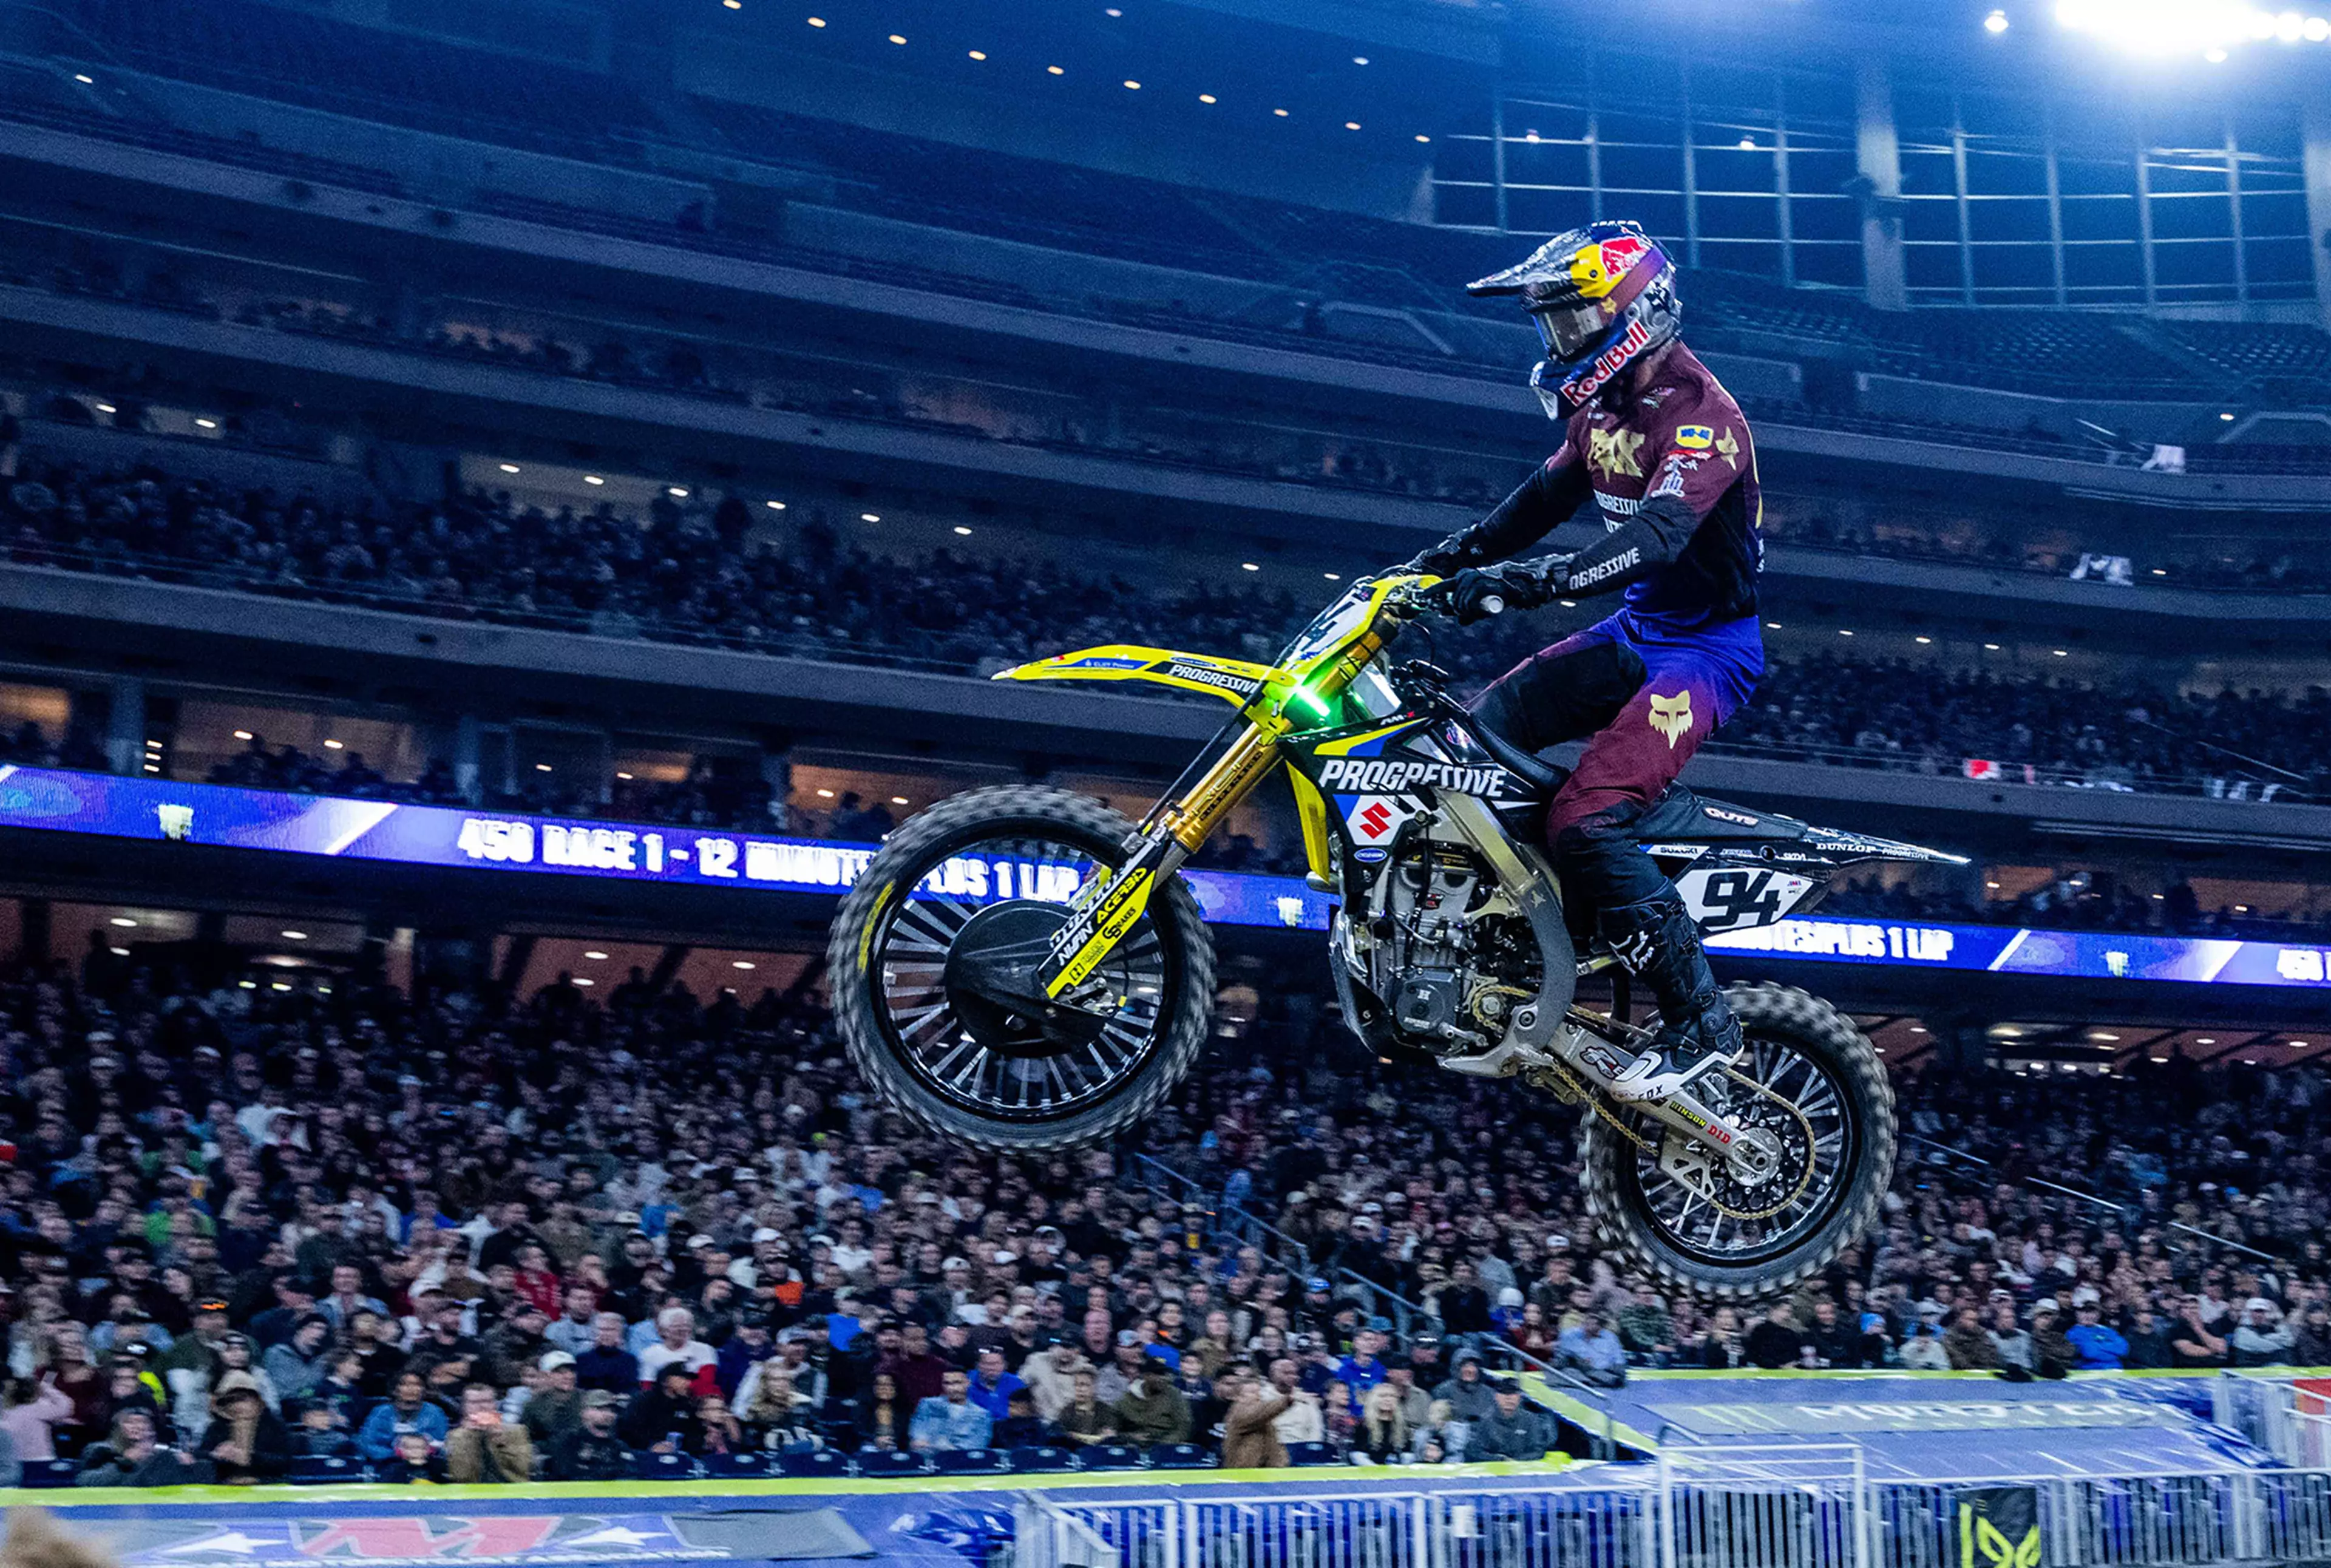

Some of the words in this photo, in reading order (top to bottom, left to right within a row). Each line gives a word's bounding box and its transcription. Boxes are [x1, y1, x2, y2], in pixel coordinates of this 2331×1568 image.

[1559, 357, 1614, 407] Red
[1603, 319, 1651, 372] Bull
[458, 818, 533, 862] 450
[543, 824, 636, 871] RACE
[642, 833, 663, 872] 1
[695, 838, 738, 878] 12
[1816, 843, 1877, 854] DUNLOP
[994, 861, 1012, 898] 1
[1096, 867, 1147, 924] ACERBIS
[1702, 871, 1782, 929] 94
[1670, 1101, 1707, 1127] HINSON
